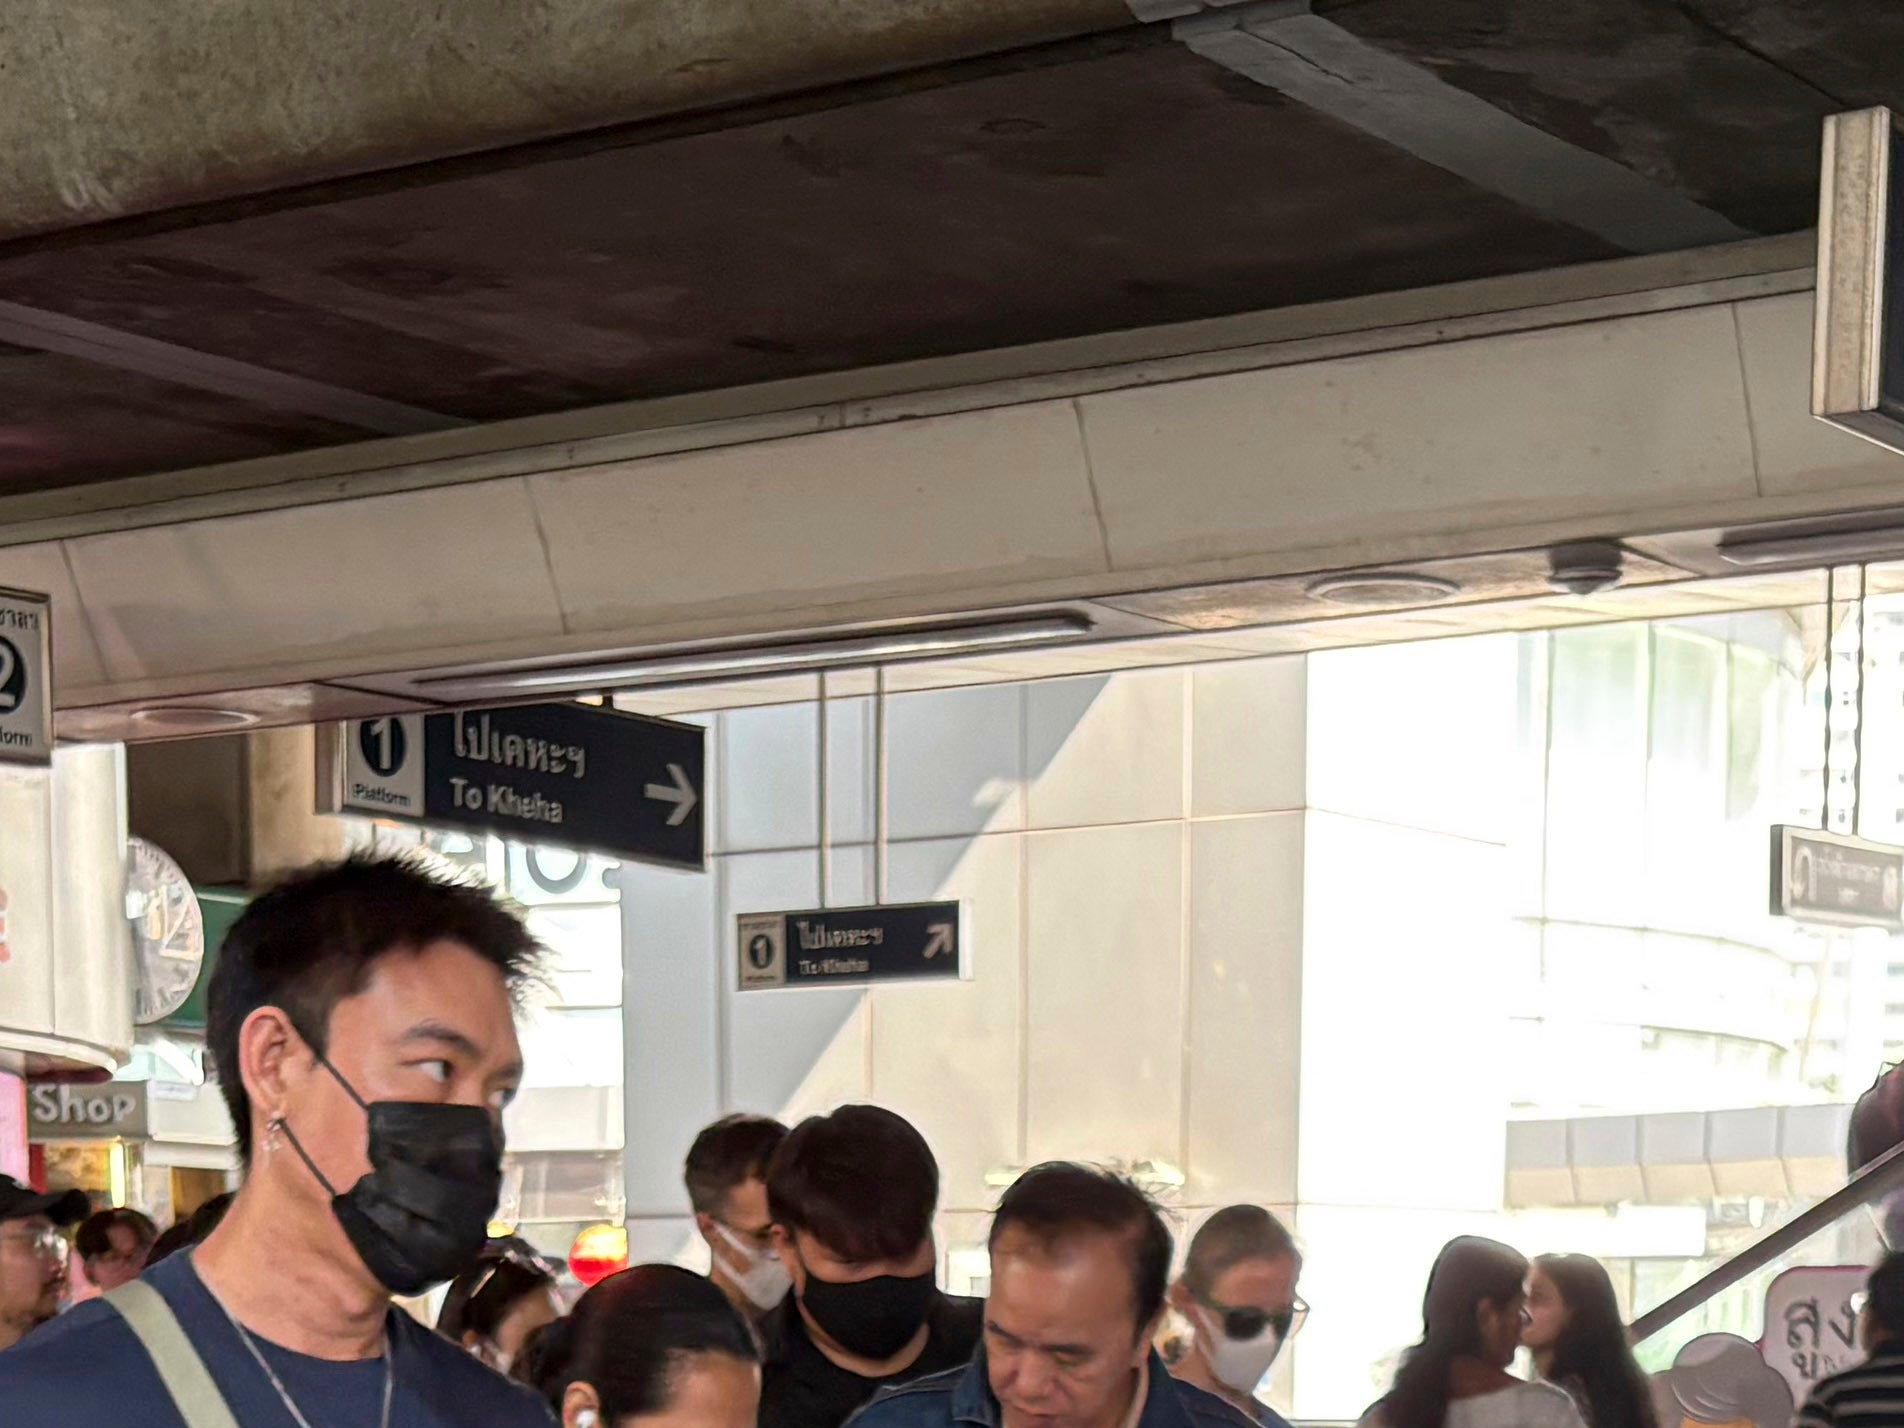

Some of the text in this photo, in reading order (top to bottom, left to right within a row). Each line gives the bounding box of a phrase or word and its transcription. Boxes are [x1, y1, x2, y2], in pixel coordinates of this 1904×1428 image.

[369, 717, 393, 770] 1
[351, 782, 412, 808] Platform
[449, 777, 483, 810] To
[32, 1082, 137, 1123] Shop
